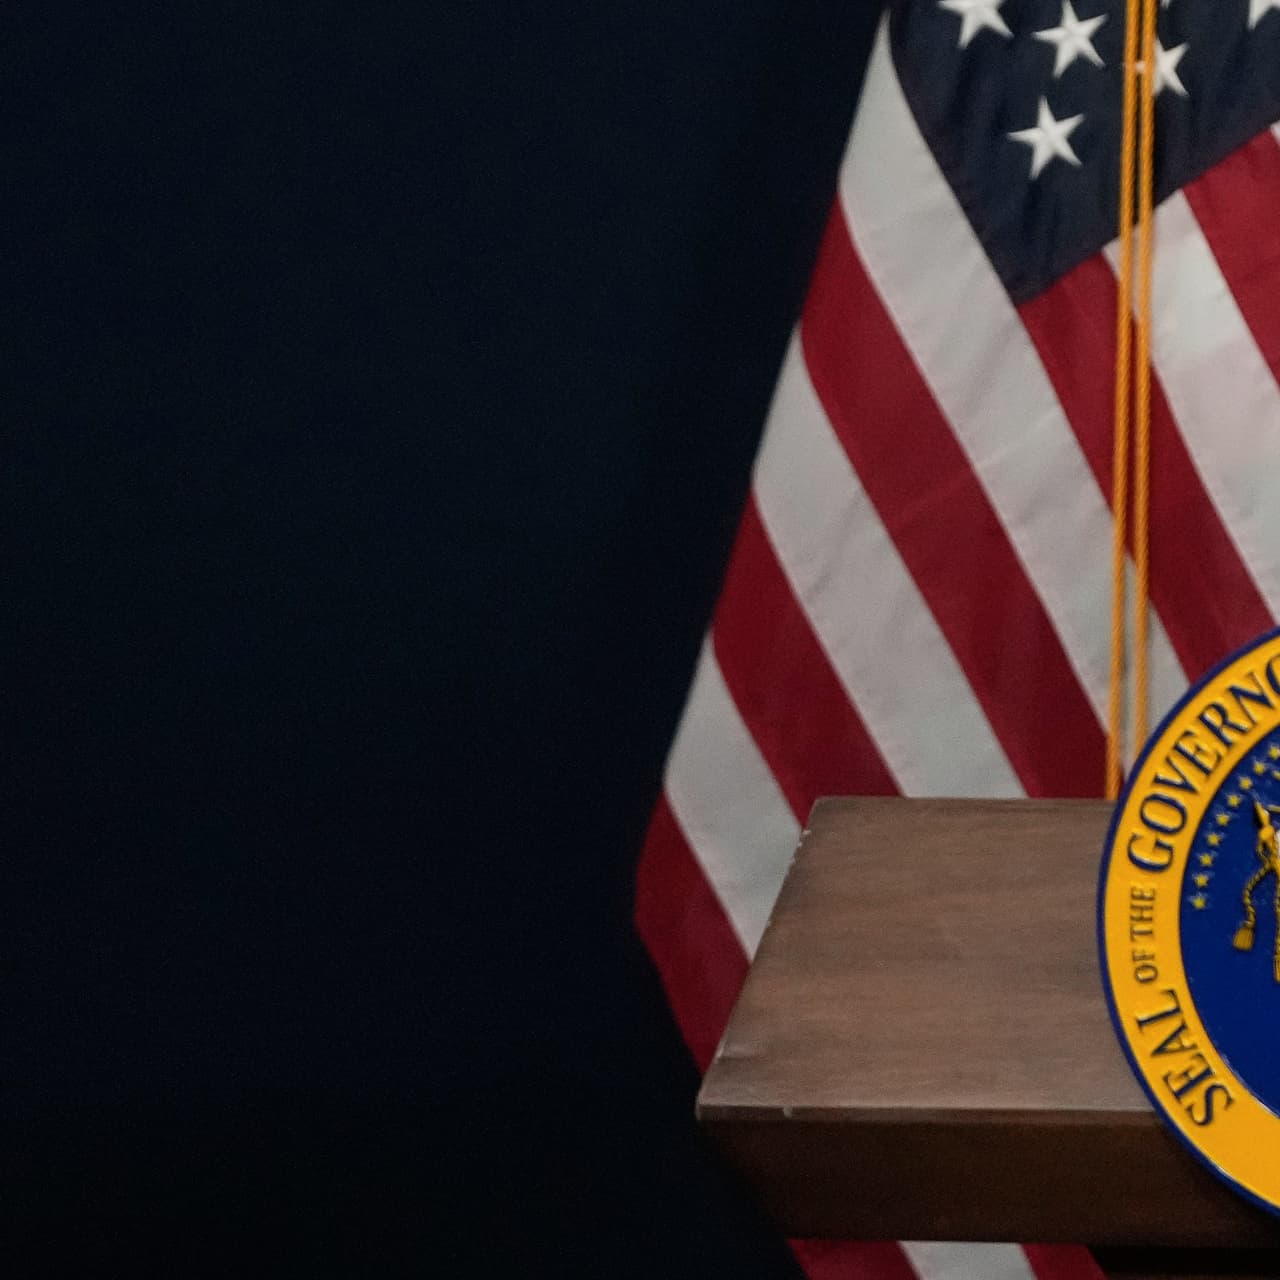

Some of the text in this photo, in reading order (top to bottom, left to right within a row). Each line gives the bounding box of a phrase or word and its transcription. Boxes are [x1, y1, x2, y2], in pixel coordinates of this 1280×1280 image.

[1129, 886, 1157, 942] THE
[1132, 947, 1158, 984] OF
[1135, 988, 1236, 1127] SEAL
